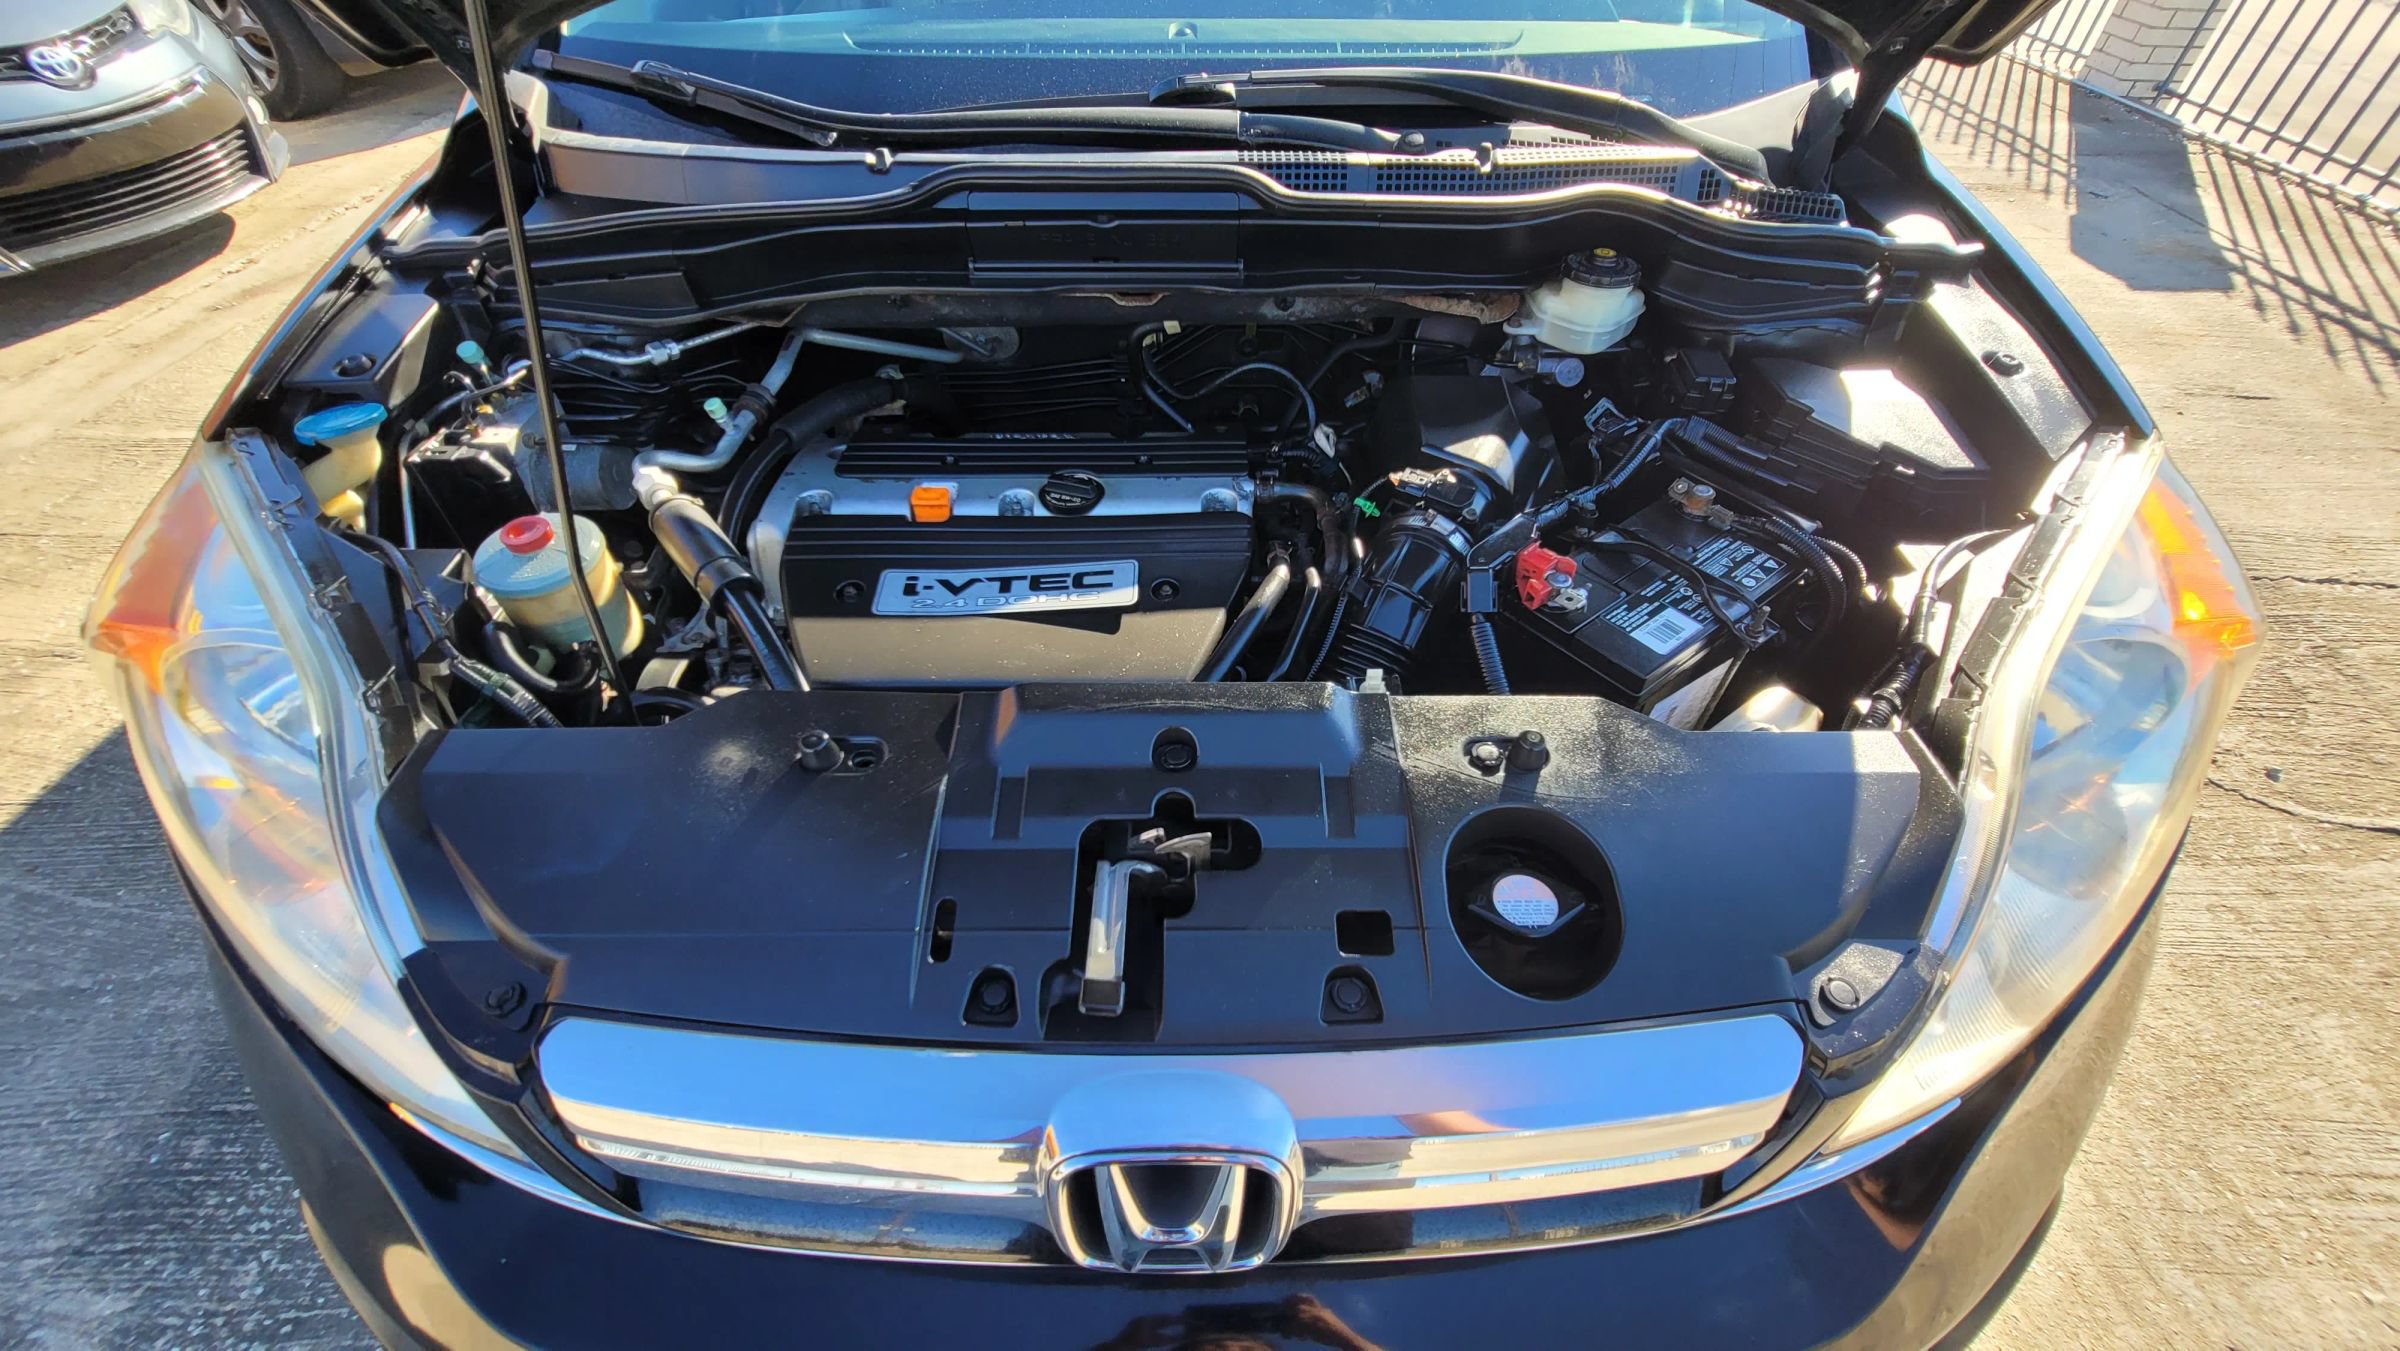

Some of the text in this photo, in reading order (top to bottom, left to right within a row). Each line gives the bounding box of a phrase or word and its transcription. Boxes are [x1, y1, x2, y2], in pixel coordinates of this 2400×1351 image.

[903, 570, 1114, 597] i-VTEC
[911, 591, 1100, 608] 2.4 DOHC
